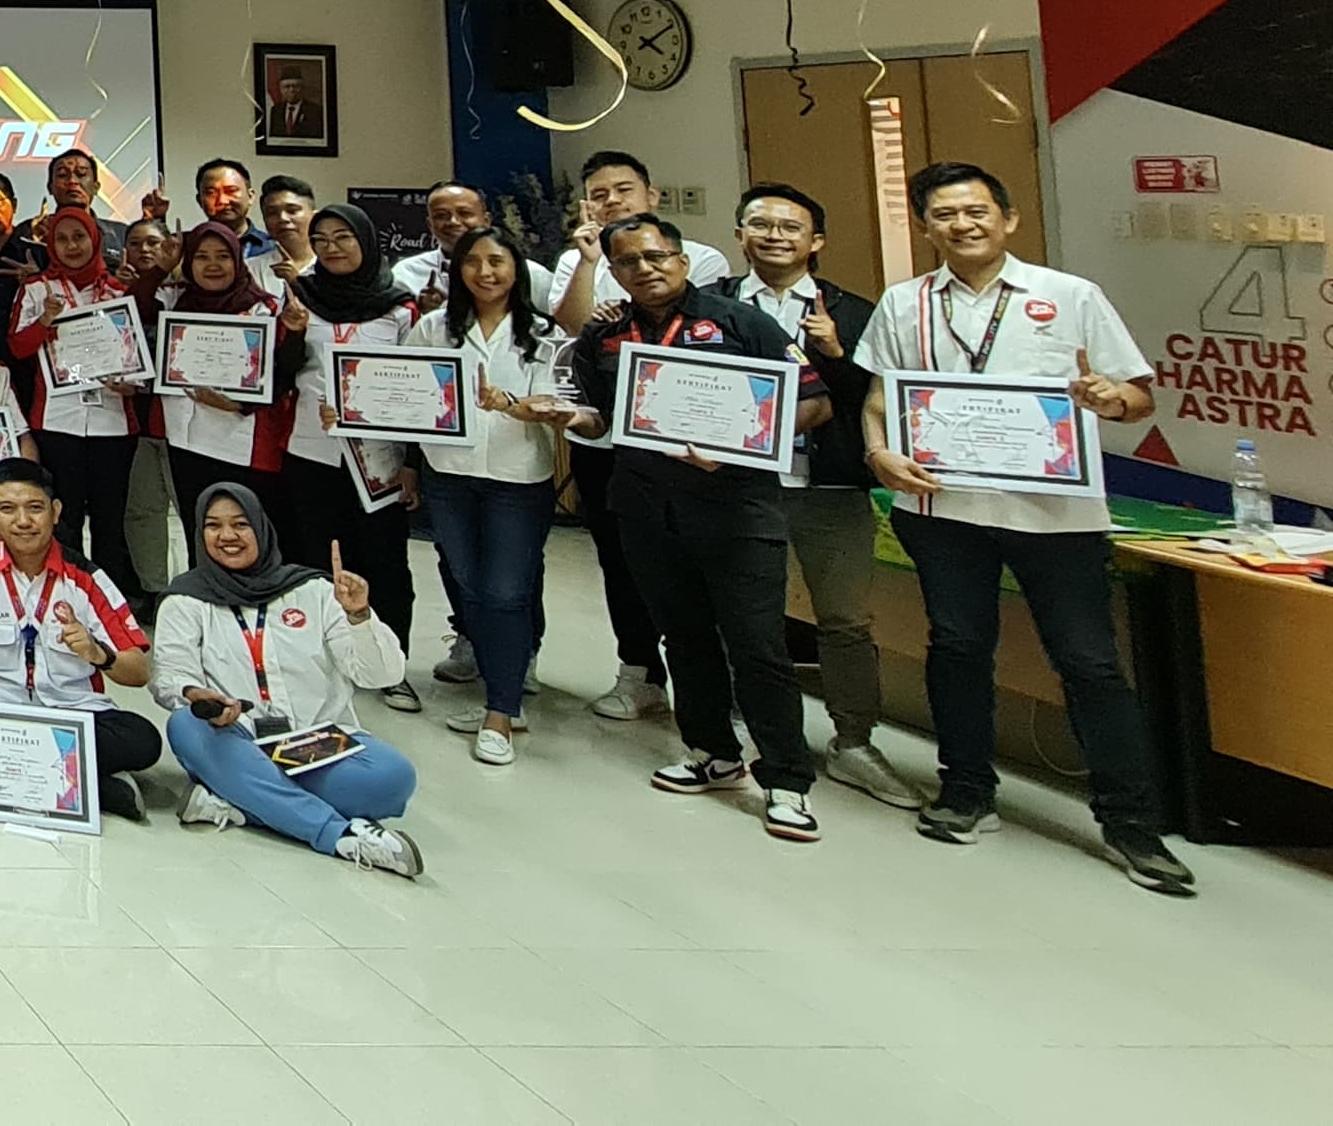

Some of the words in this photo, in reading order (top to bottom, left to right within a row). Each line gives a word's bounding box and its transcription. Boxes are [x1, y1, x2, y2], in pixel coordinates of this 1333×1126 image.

[390, 233, 428, 251] Road
[1200, 245, 1306, 358] 4
[1166, 333, 1308, 373] CATUR
[1155, 361, 1313, 405] HARMA
[1177, 393, 1317, 436] ASTRA
